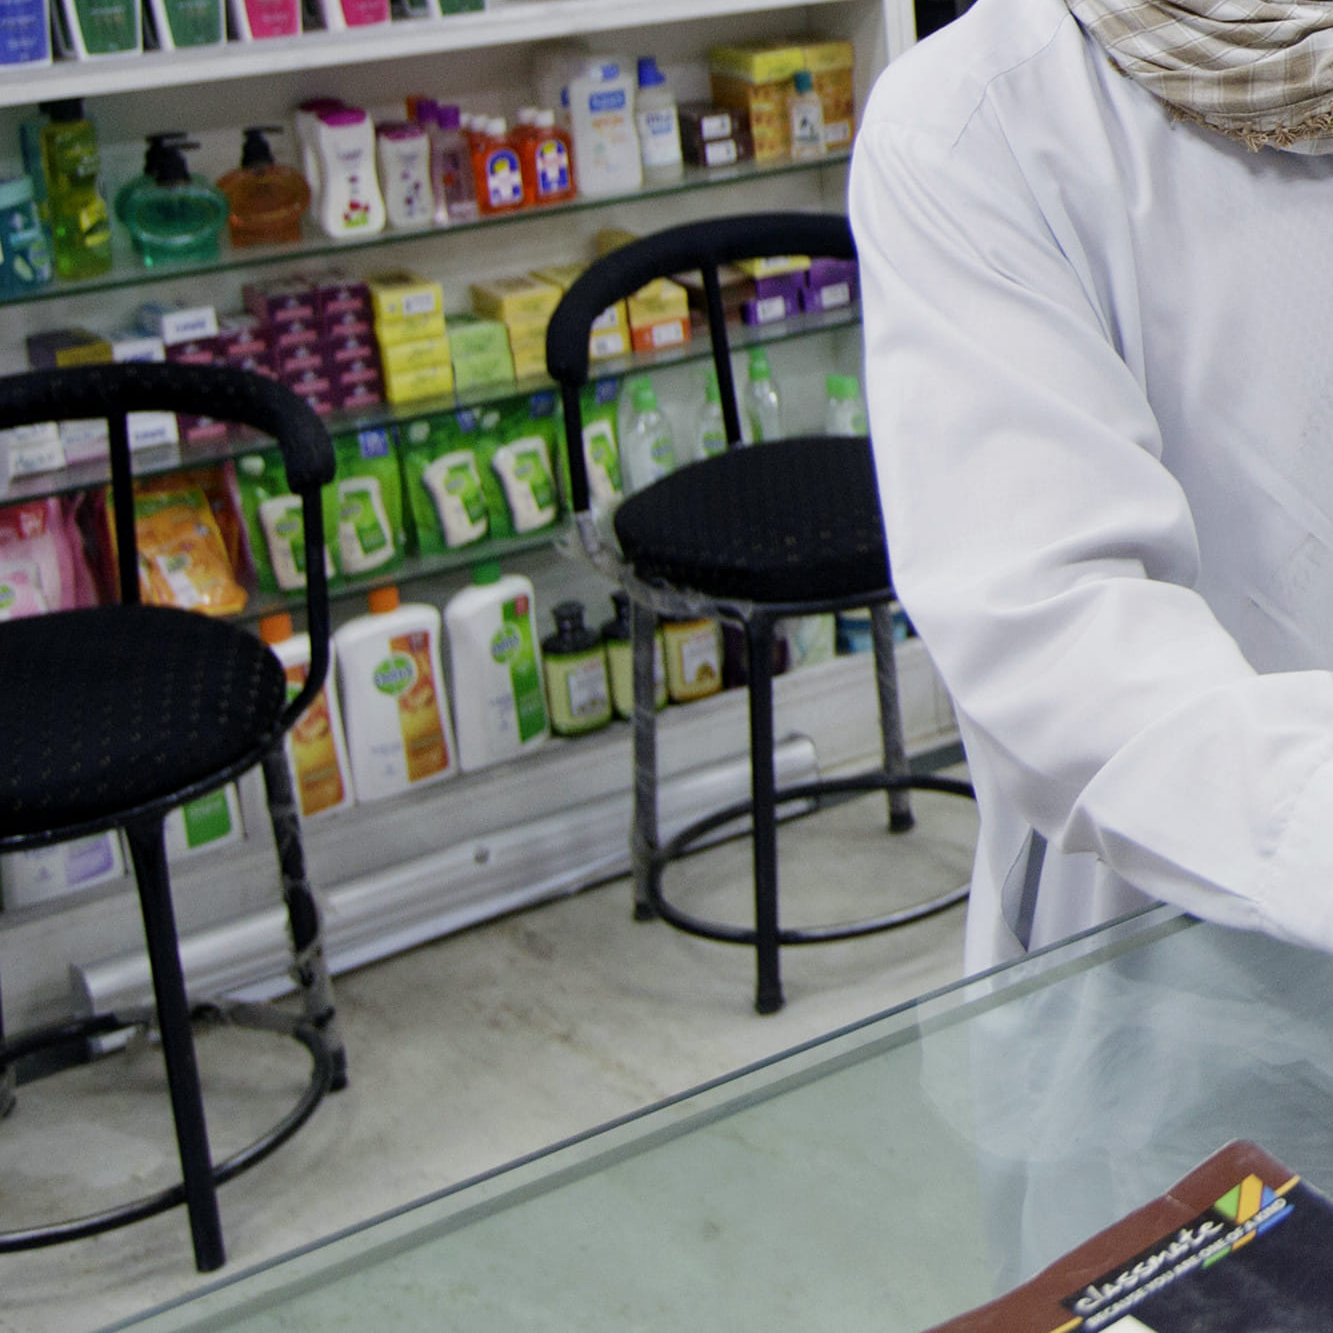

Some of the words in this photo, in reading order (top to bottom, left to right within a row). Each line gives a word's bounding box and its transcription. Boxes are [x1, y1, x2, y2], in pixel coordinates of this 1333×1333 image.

[1073, 1220, 1225, 1315] classmate
[1147, 1269, 1174, 1291] YOU
[1173, 1253, 1198, 1275] ARE
[1199, 1237, 1227, 1260] ONE
[1226, 1226, 1245, 1242] OF
[1253, 1197, 1285, 1222] KIND
